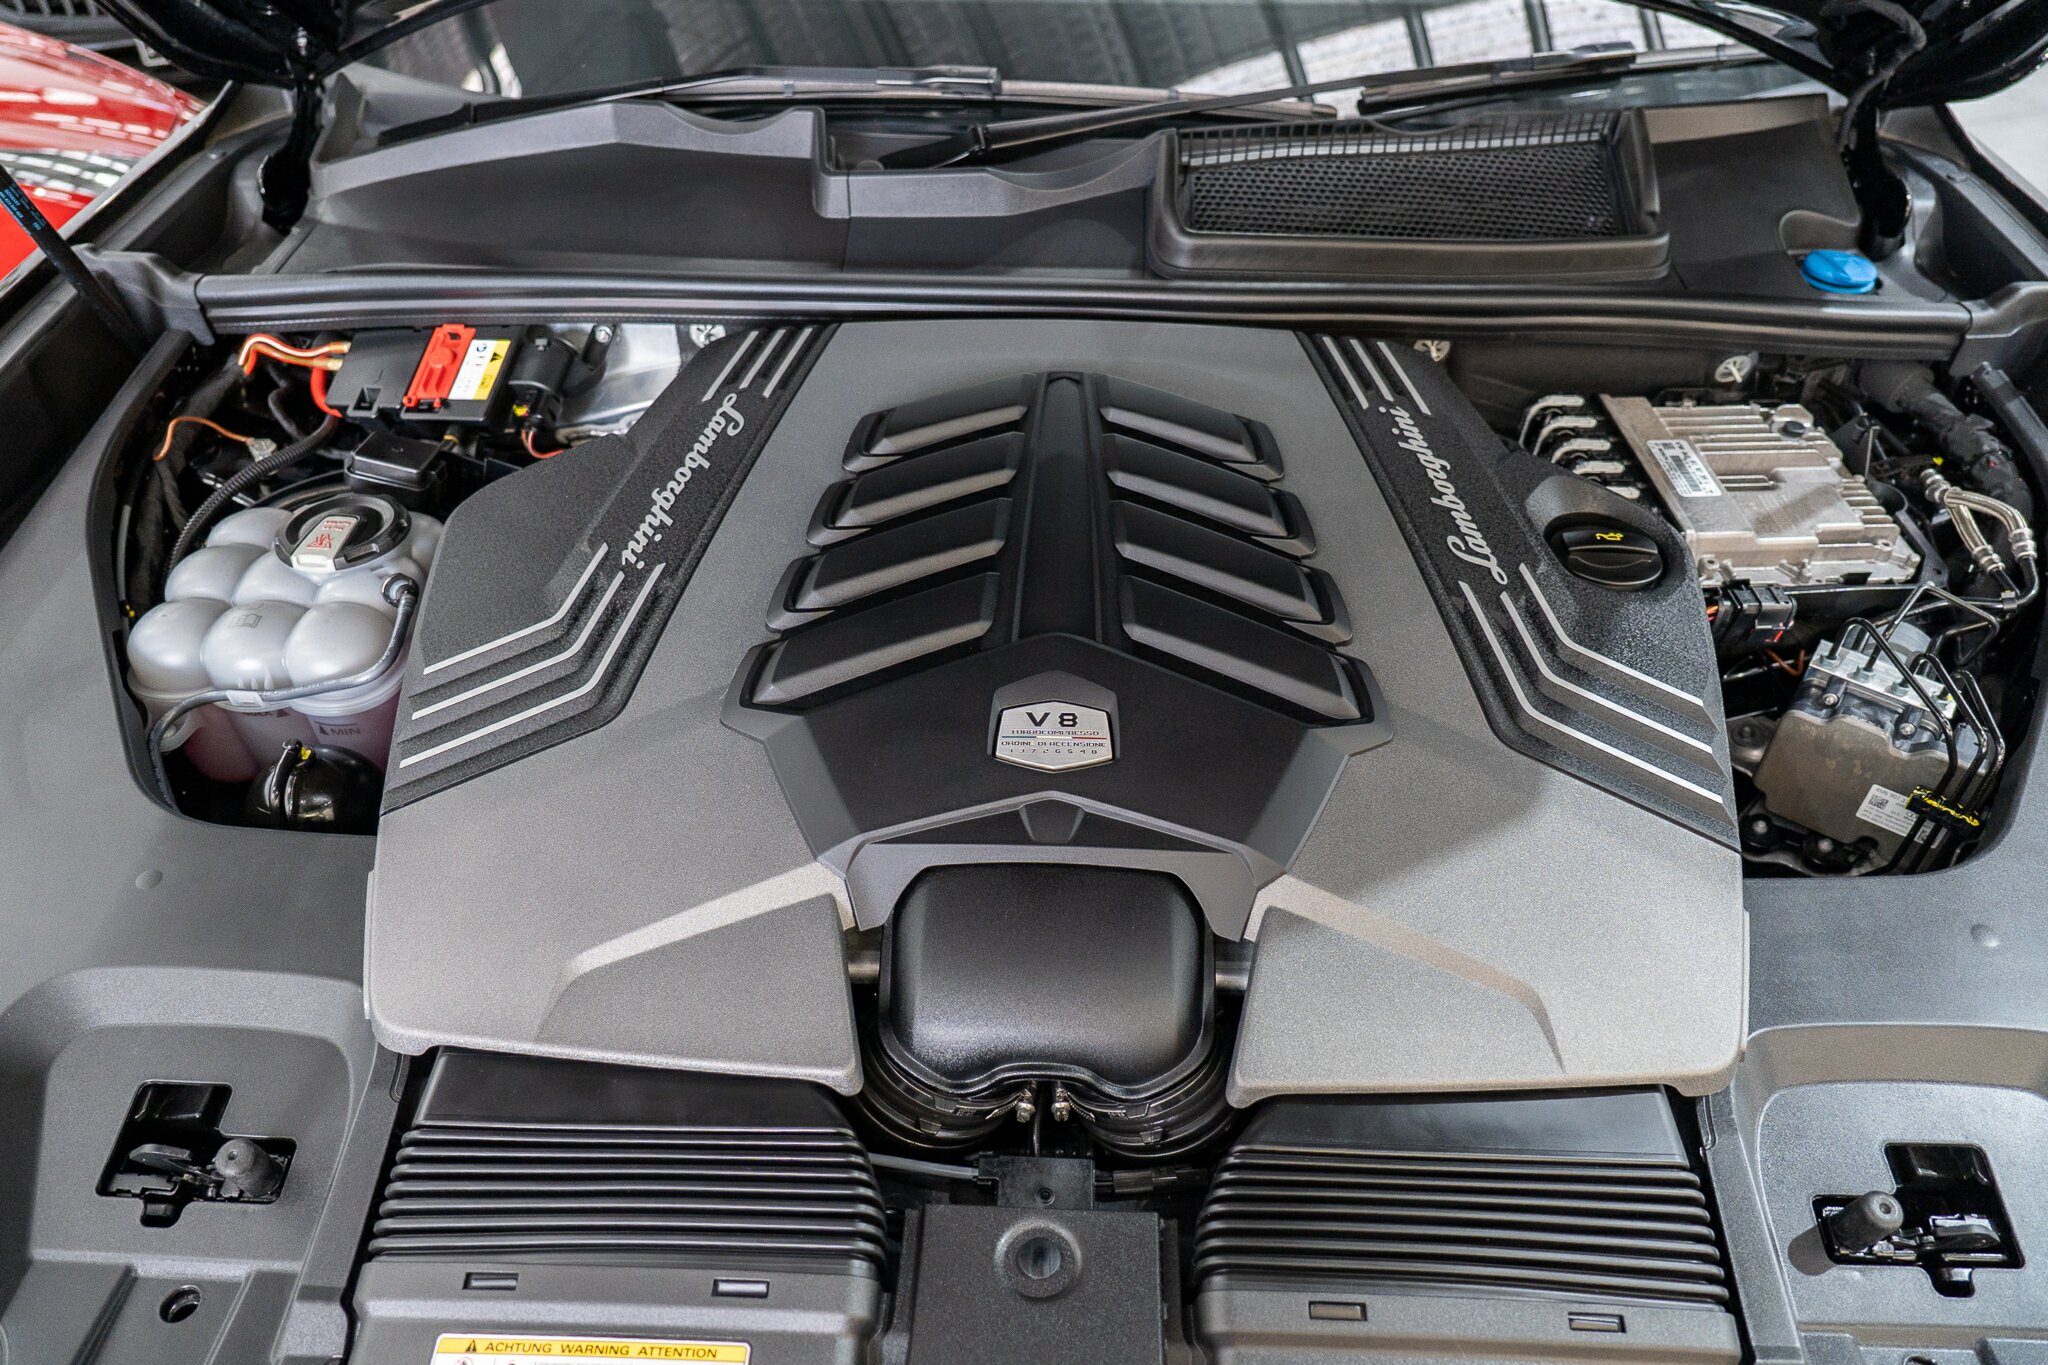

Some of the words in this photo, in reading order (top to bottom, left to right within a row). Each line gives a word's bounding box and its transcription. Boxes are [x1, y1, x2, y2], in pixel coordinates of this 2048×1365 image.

[621, 392, 745, 569] Lamborghini
[1378, 405, 1508, 585] Lamborghini
[1025, 712, 1078, 727] V8
[330, 727, 361, 736] MIN
[484, 1341, 552, 1354] ACHTUNG
[561, 1343, 630, 1356] WARNING
[637, 1345, 719, 1359] ATTENTION
